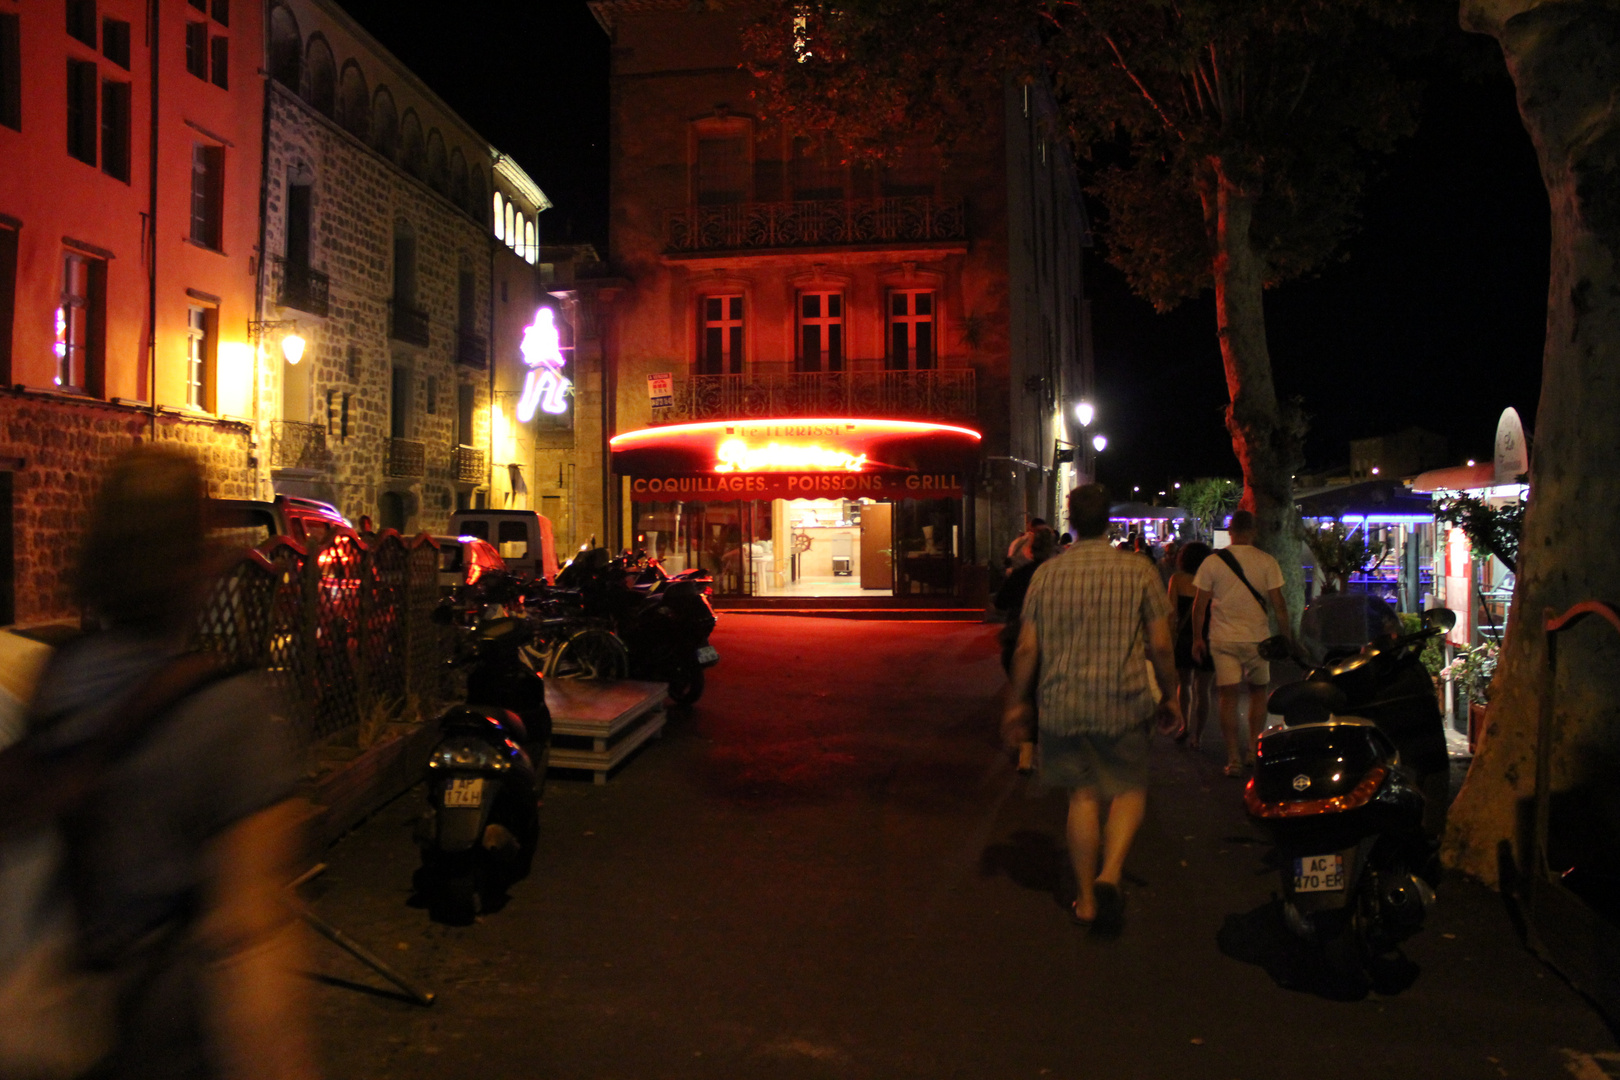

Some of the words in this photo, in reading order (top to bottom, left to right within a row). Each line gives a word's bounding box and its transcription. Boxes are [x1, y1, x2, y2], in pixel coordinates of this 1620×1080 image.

[633, 476, 765, 494] COQUILLAGES
[788, 475, 882, 492] POISSONS
[906, 474, 960, 491] GRILL
